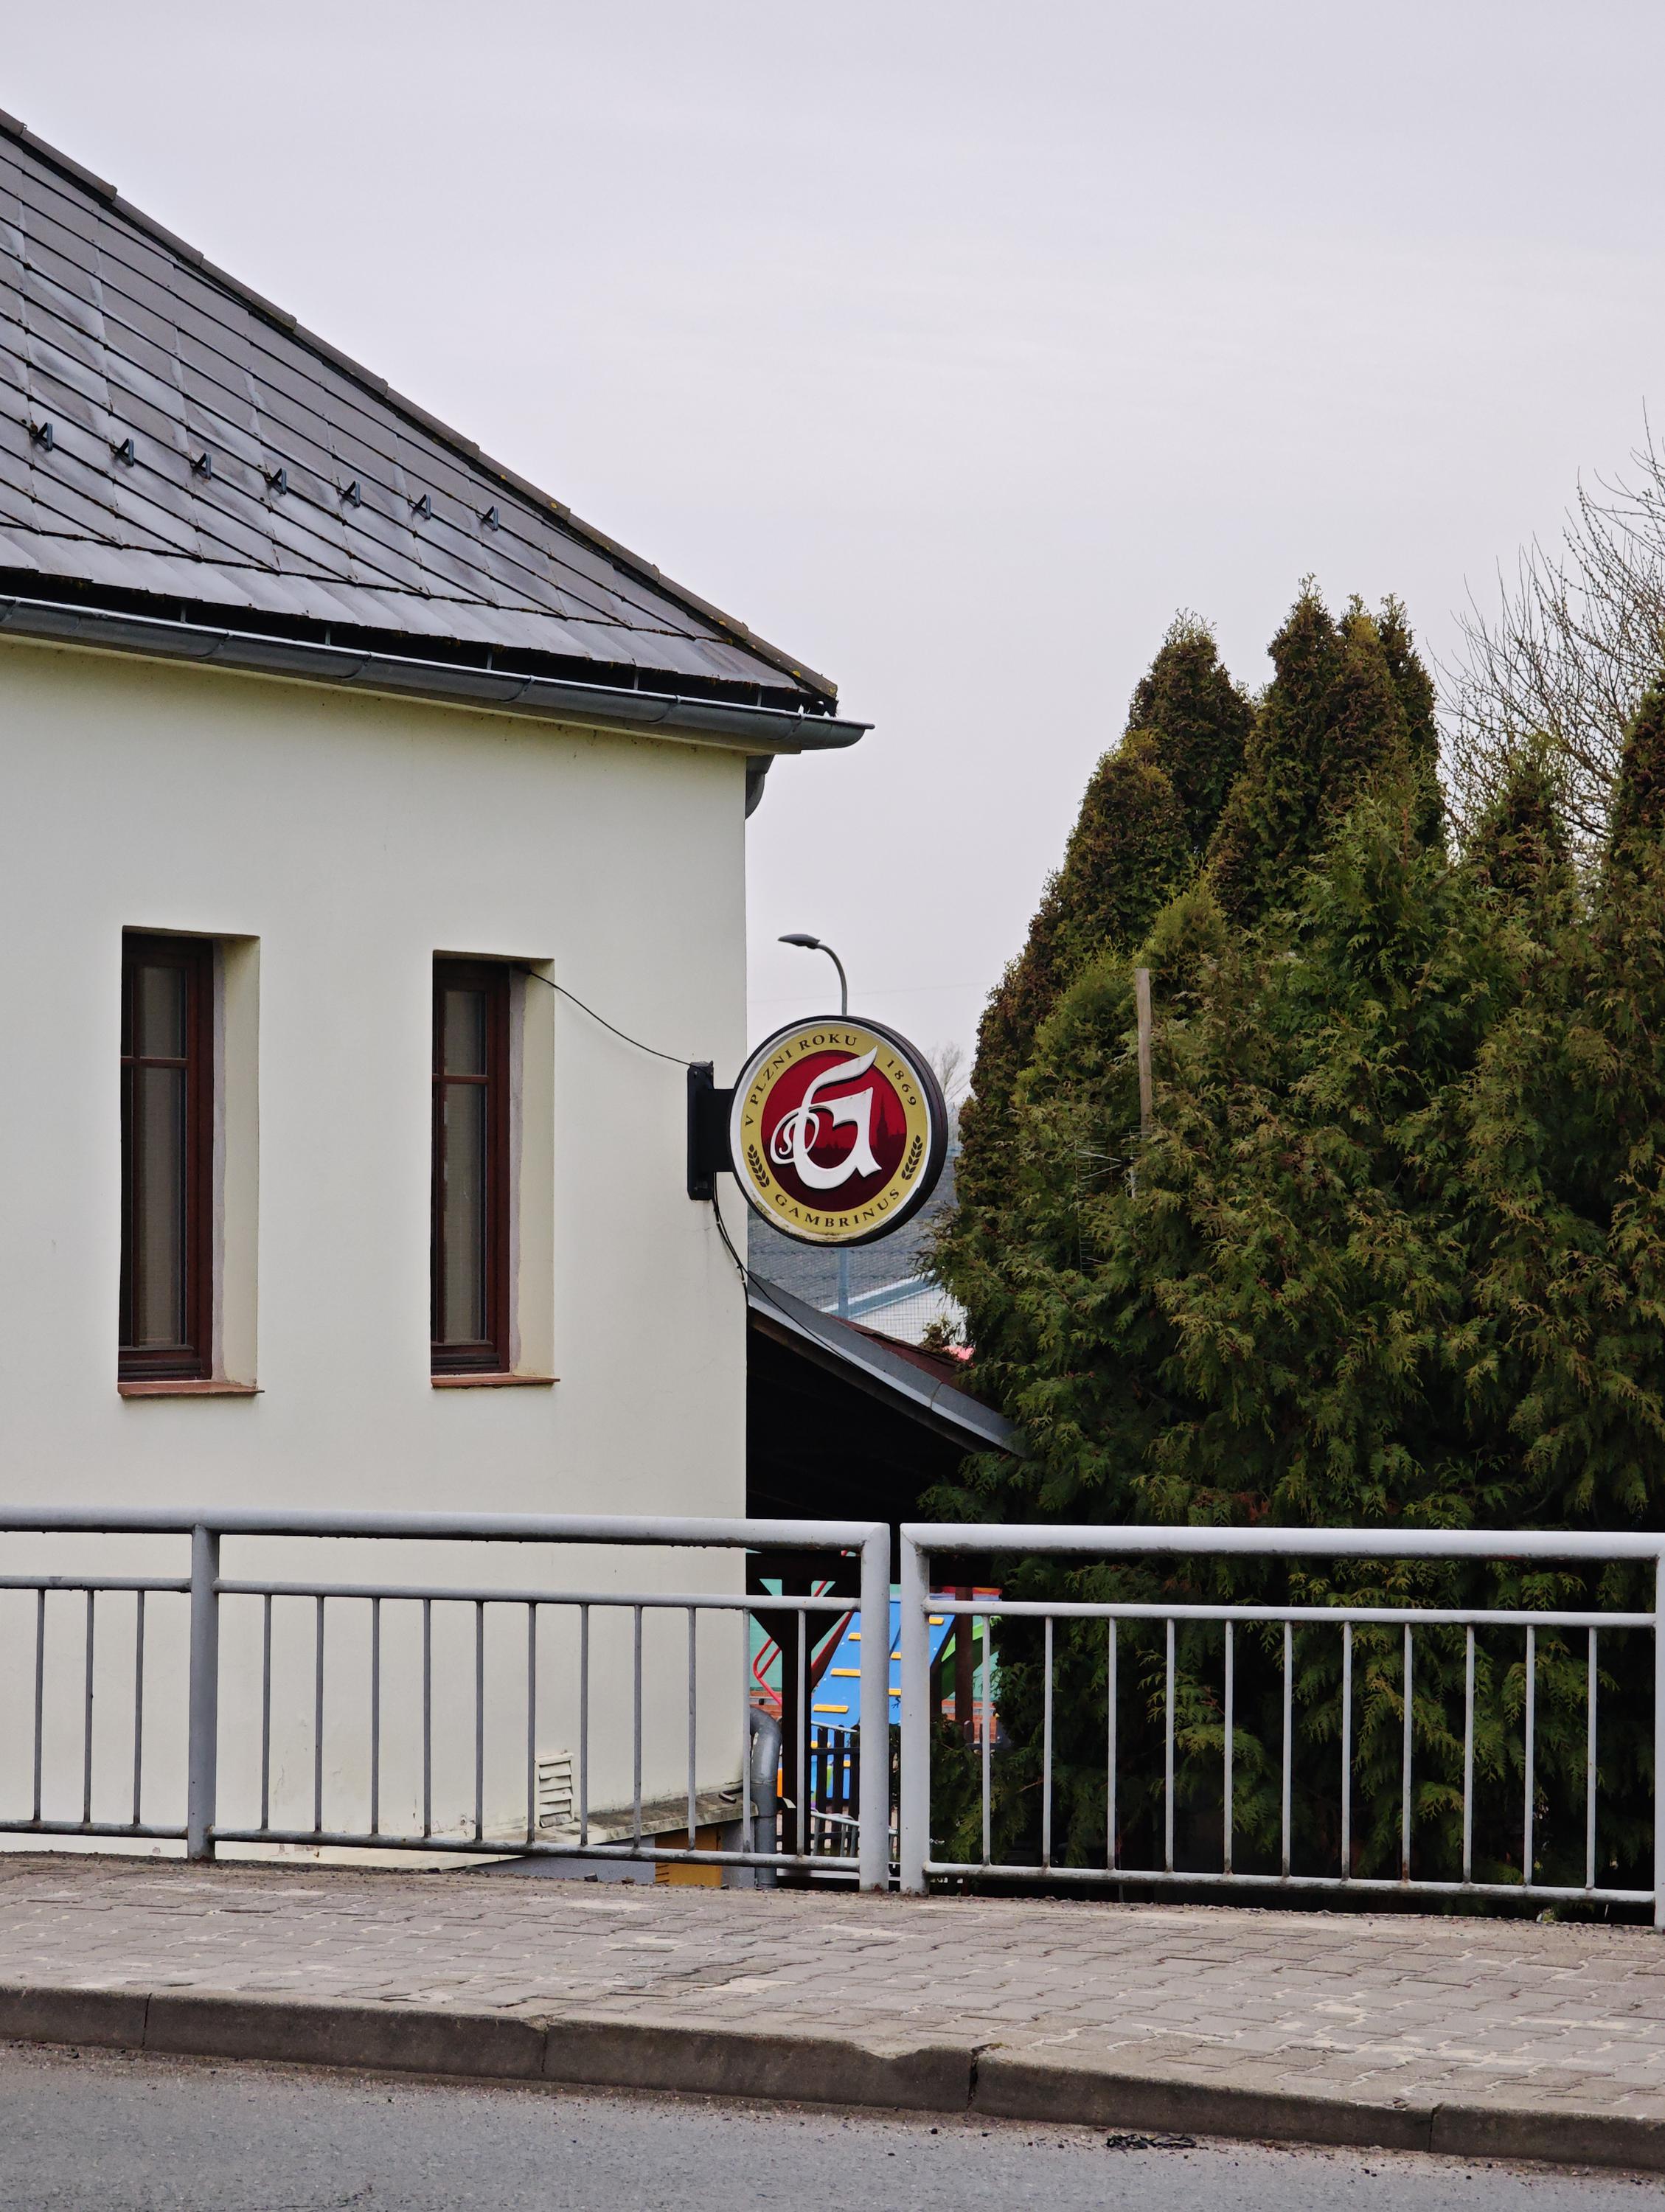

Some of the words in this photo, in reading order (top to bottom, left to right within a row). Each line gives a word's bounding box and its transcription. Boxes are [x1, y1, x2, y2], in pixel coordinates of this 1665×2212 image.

[745, 1115, 755, 1127] V
[750, 1049, 792, 1107] PLZNI
[799, 1033, 858, 1051] ROKU
[886, 1060, 917, 1107] 1869
[774, 1188, 900, 1228] GAMBRINUS
